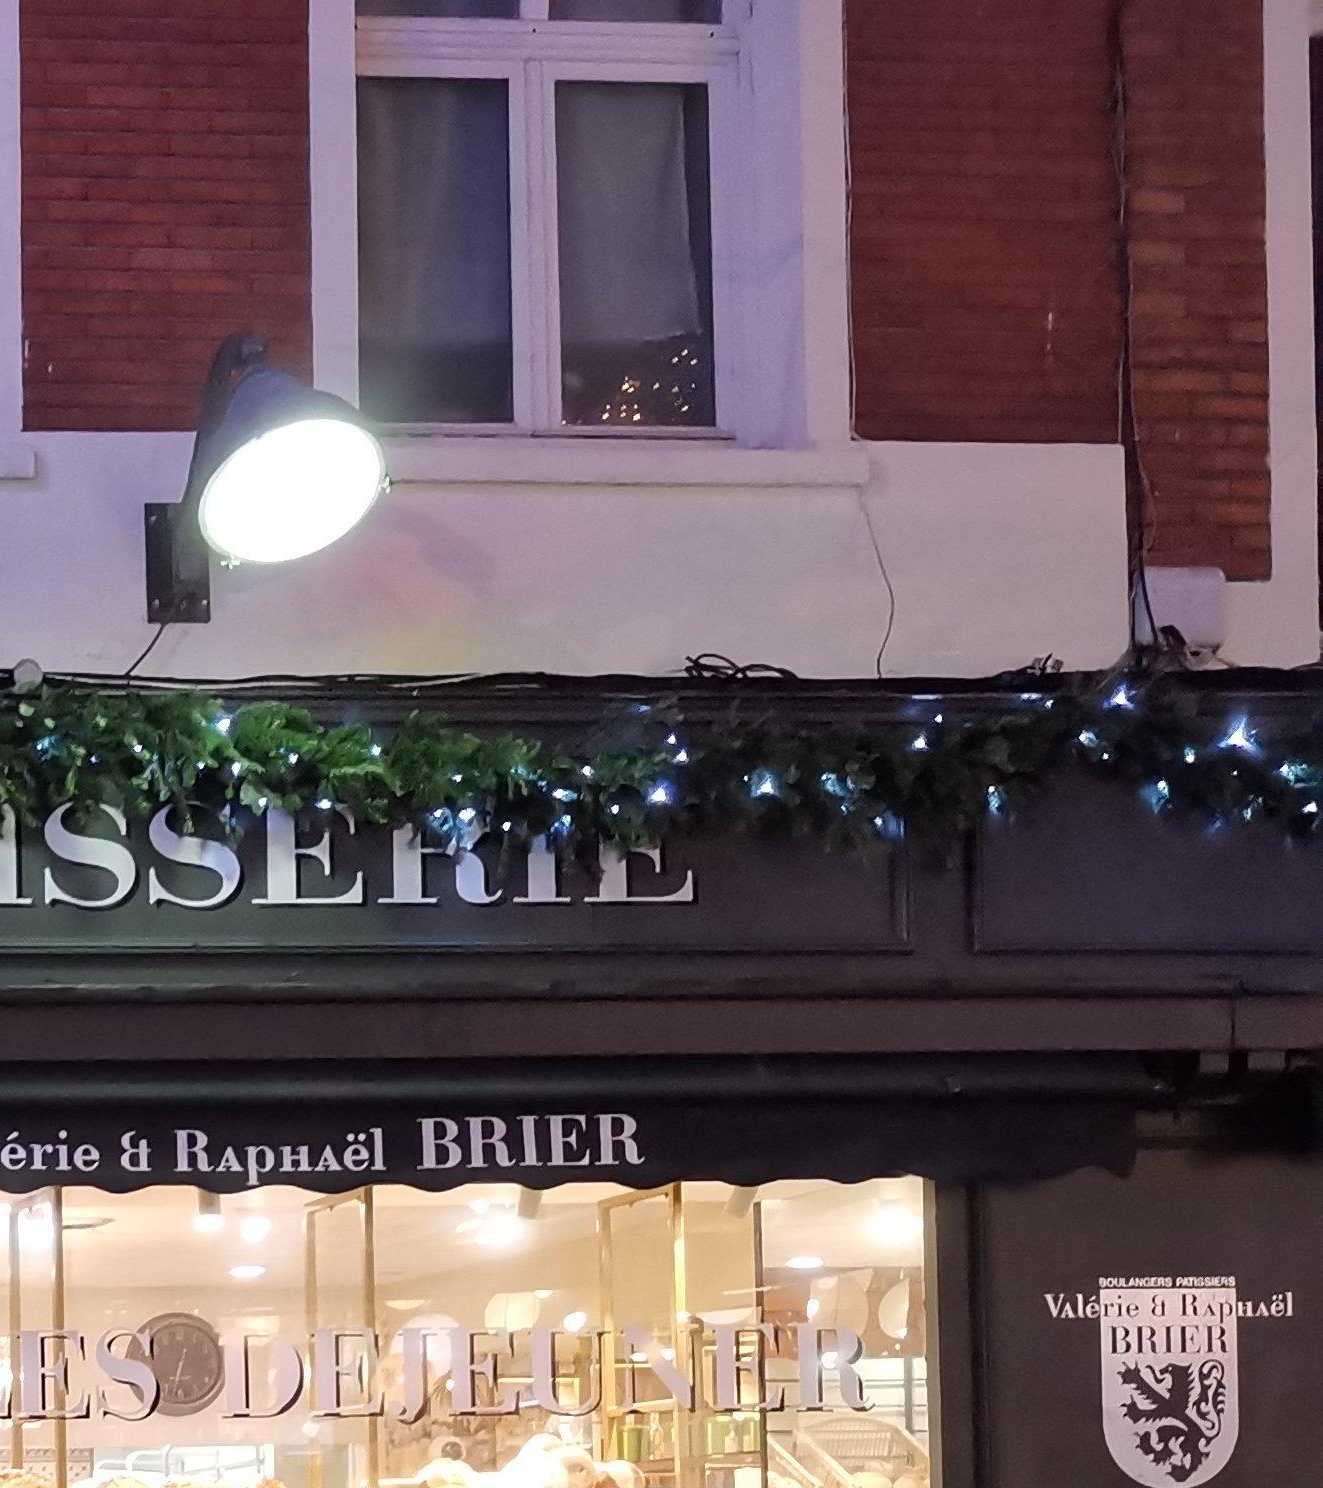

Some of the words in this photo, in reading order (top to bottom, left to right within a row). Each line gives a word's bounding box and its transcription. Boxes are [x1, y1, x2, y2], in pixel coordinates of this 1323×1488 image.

[119, 1128, 152, 1173] &
[415, 1113, 645, 1171] BRIER
[1099, 1277, 1172, 1288] BOULANGERS
[1176, 1276, 1236, 1287] PATISSIERS
[1151, 1295, 1167, 1317] &
[1110, 1324, 1229, 1355] BRIER
[221, 1320, 877, 1421] DEJEUNER
